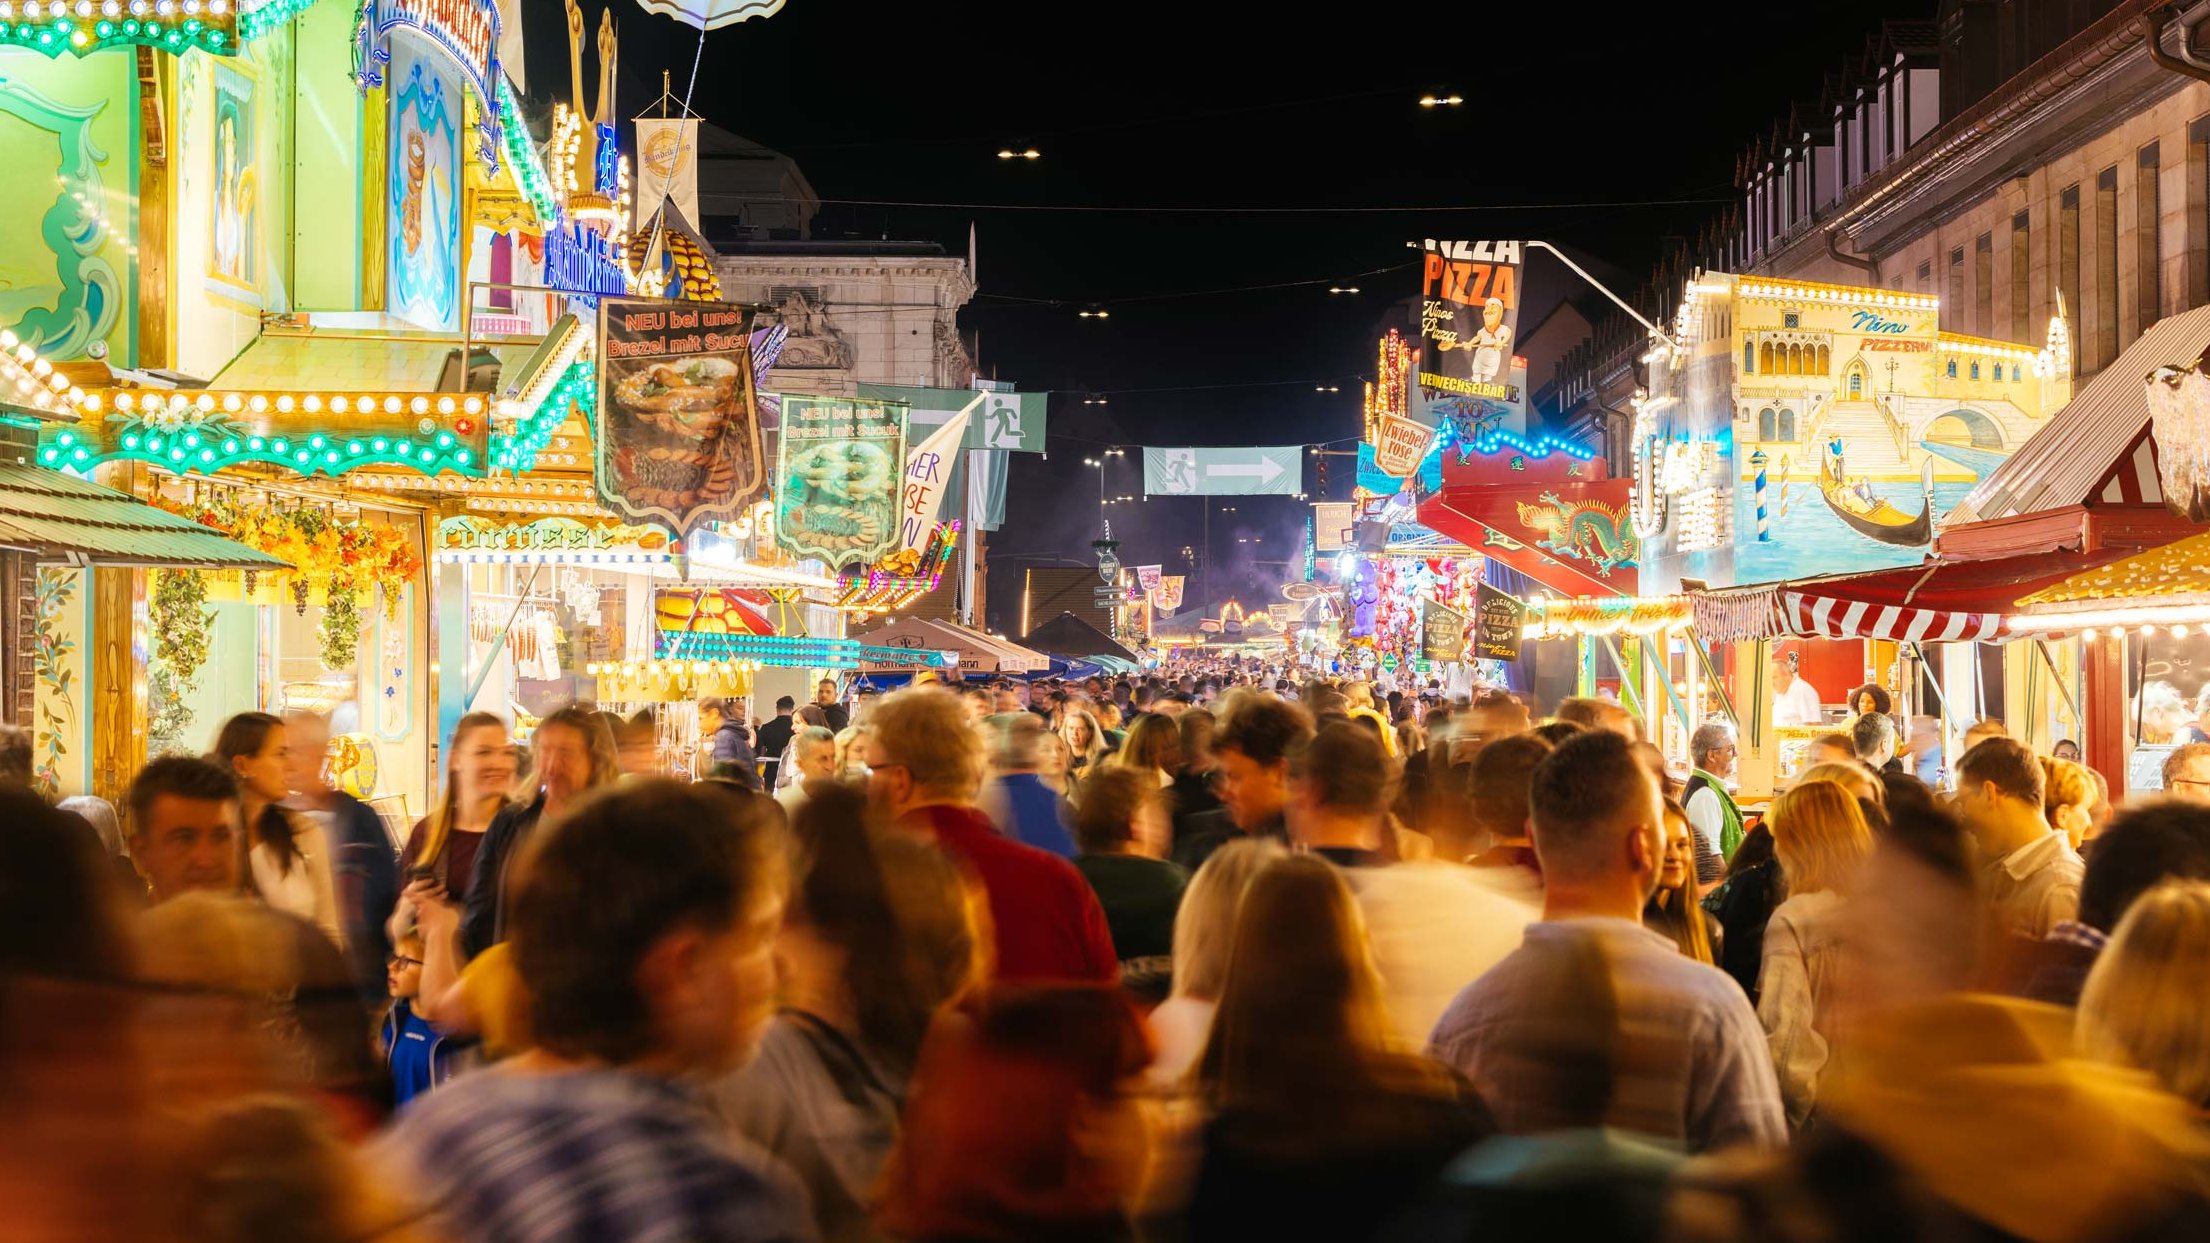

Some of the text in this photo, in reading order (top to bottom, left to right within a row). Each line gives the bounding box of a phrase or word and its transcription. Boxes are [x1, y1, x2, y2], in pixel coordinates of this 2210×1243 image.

[1425, 239, 1520, 264] IZZA
[1424, 254, 1515, 309] PIZZA
[625, 310, 742, 332] NEU bei uns!
[1422, 318, 1458, 341] Pizza
[1852, 311, 1909, 333] Nino
[608, 336, 665, 356] Brezel
[670, 335, 701, 353] mit
[801, 406, 884, 420] NEU bei uns!
[1455, 402, 1483, 418] TO
[788, 422, 899, 438] Brezel mit Sucuk
[1385, 422, 1428, 448] Zwiebel-
[1387, 440, 1413, 460] rose
[1481, 598, 1518, 615] DELICIOUS
[1425, 623, 1459, 635] PIZZA
[1478, 612, 1520, 628] PIZZA
[1491, 629, 1513, 641] TOWN
